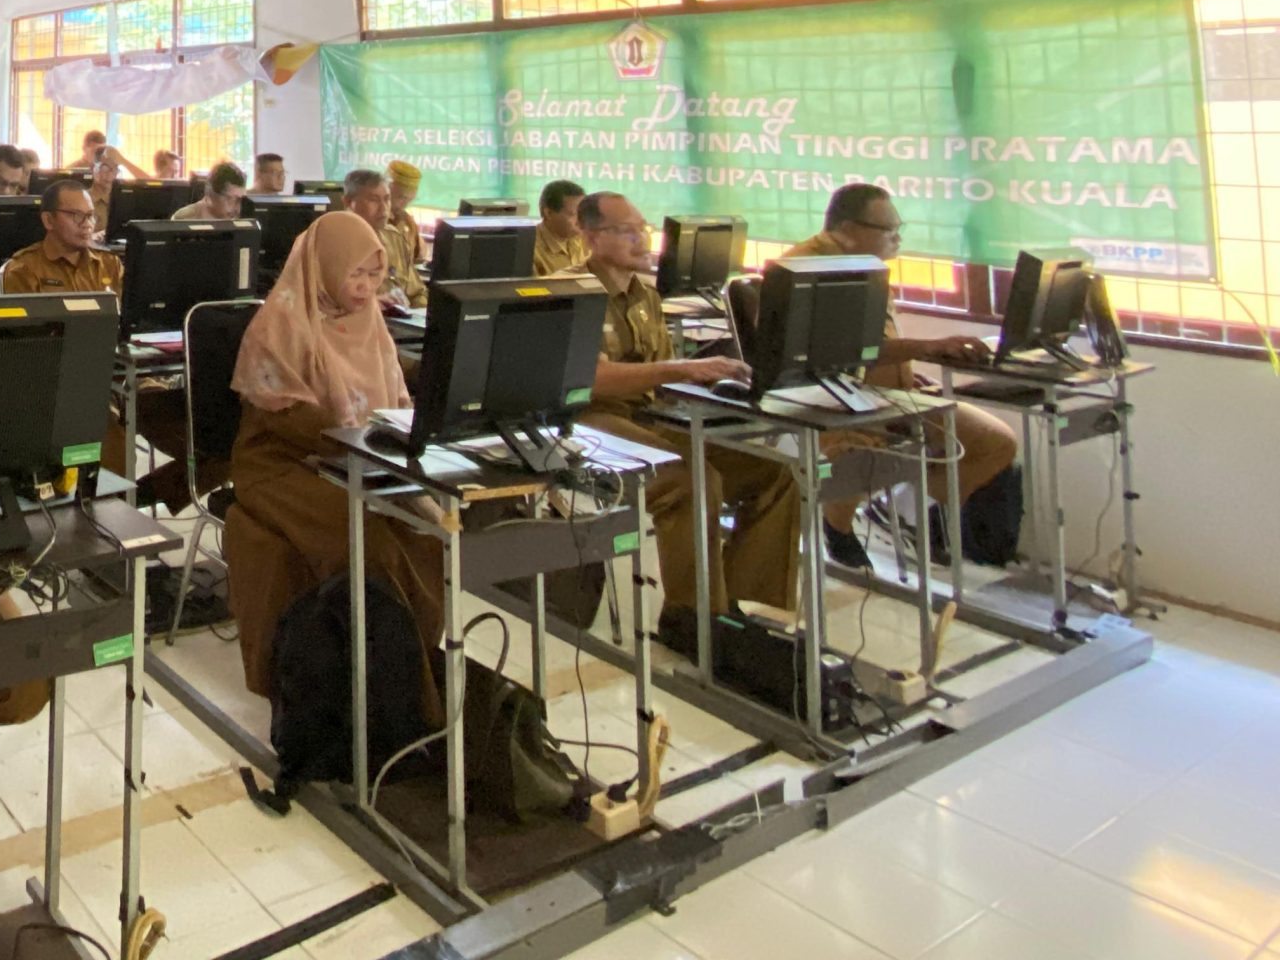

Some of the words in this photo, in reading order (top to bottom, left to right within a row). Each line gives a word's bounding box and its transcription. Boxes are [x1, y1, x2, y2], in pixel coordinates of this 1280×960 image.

[498, 87, 628, 127] Selamat
[632, 83, 798, 135] Datang
[331, 126, 408, 144] PESERTA
[414, 128, 494, 147] SELEKSI
[503, 129, 616, 151] JABATAN
[624, 130, 783, 155] PIMPINAN
[789, 133, 930, 160] TINGGI
[943, 136, 1200, 165] PRATAMA
[487, 157, 635, 181] PEMERINTAH
[642, 163, 835, 193] KABUPATEN
[1007, 179, 1179, 210] KUALA
[1102, 244, 1163, 258] BKPP
